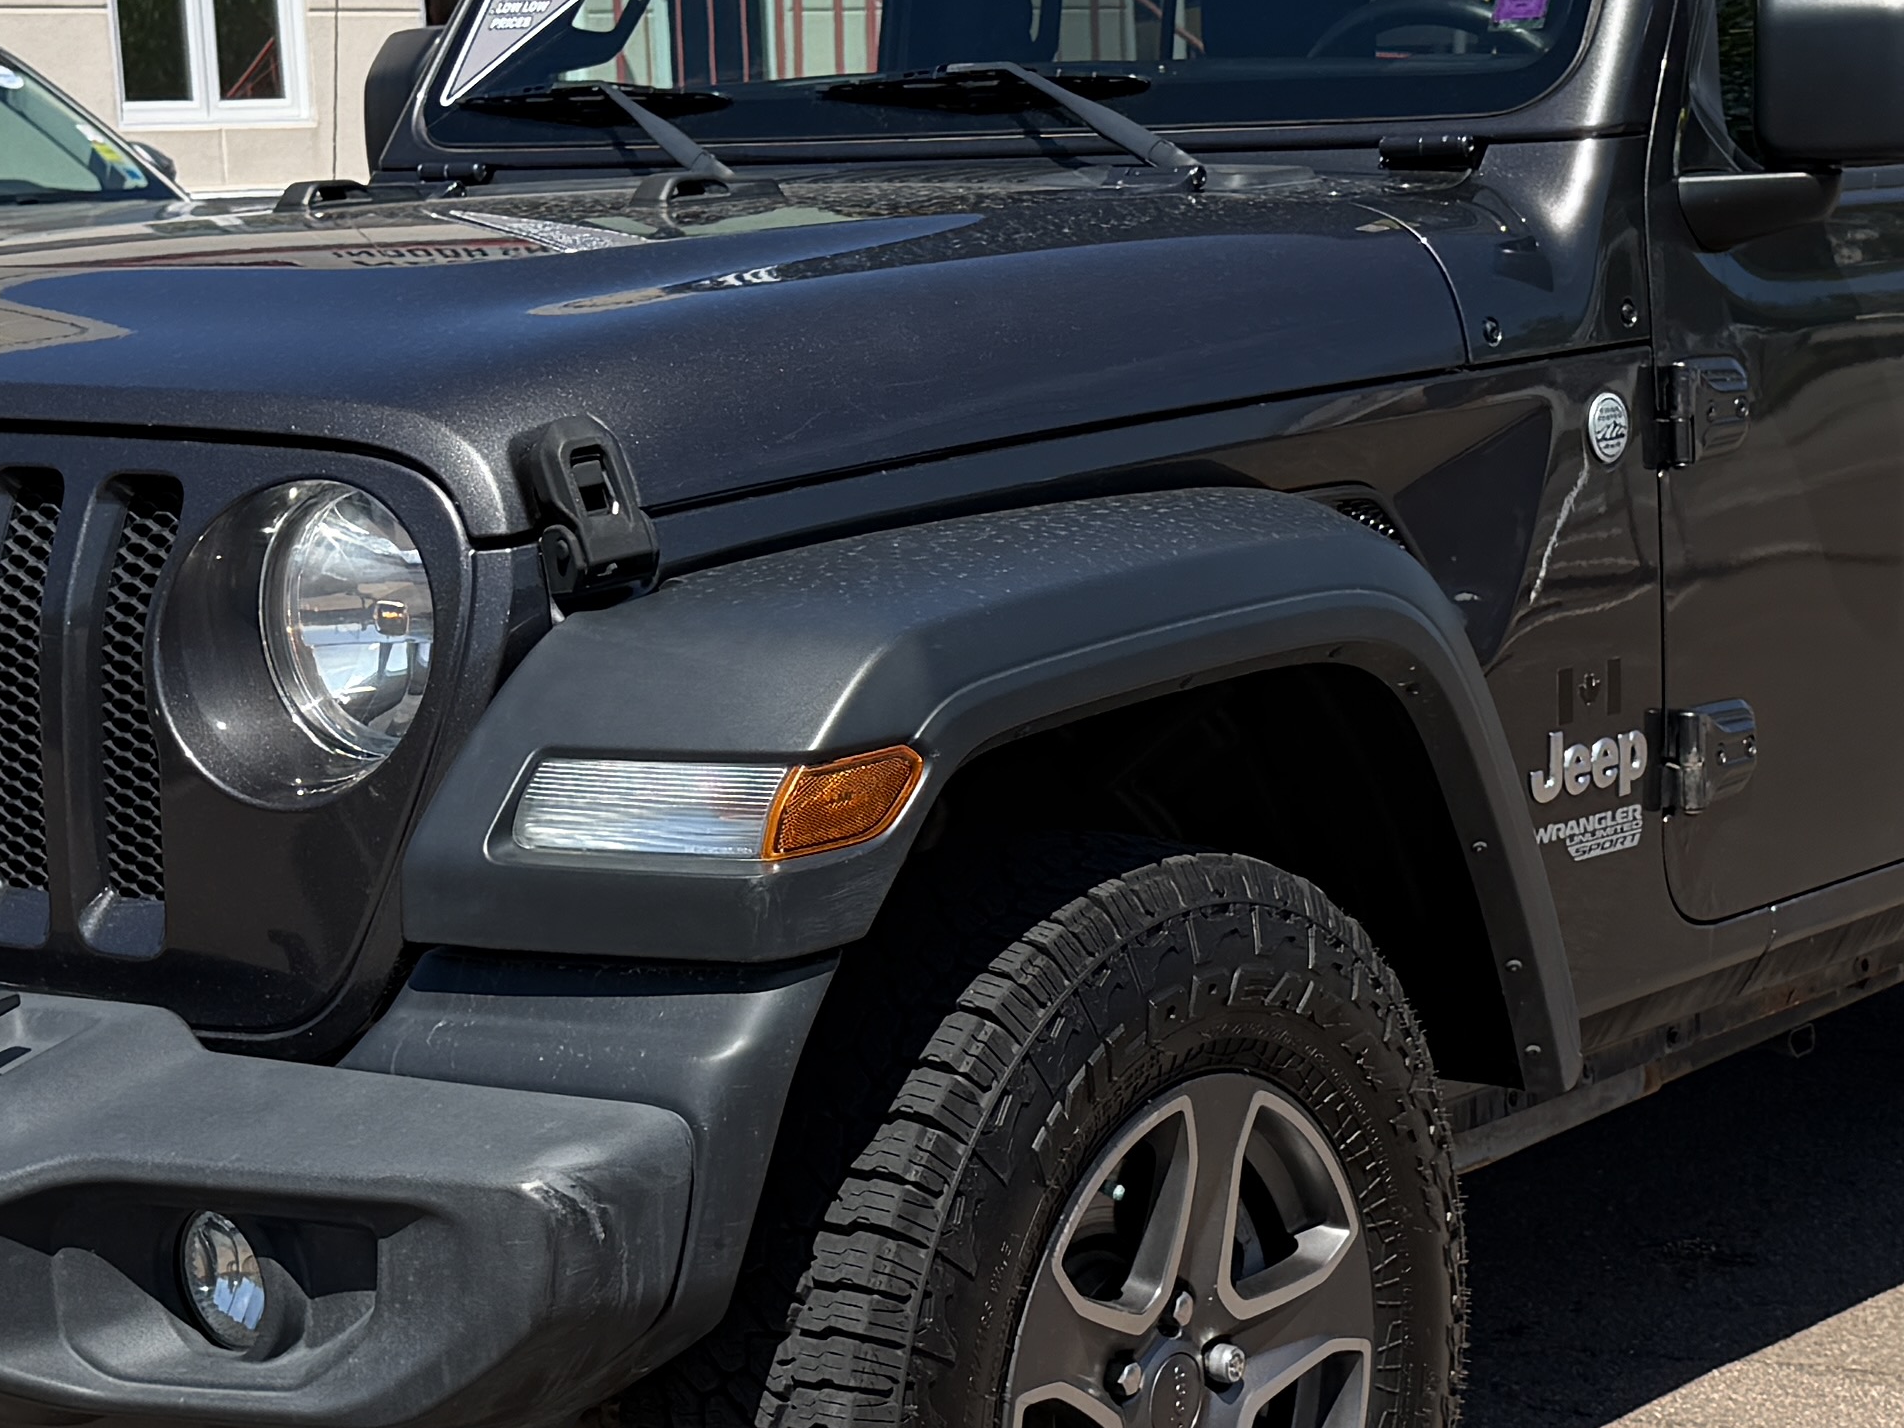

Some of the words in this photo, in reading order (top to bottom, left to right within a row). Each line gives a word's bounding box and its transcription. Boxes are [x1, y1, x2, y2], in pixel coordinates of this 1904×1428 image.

[496, 1, 523, 14] LOW
[521, 0, 552, 13] LOW
[1529, 729, 1648, 804] Jeep
[1536, 804, 1643, 844] WRANGLER
[1566, 820, 1643, 846] UNLIMITED
[1575, 834, 1638, 856] SPORT
